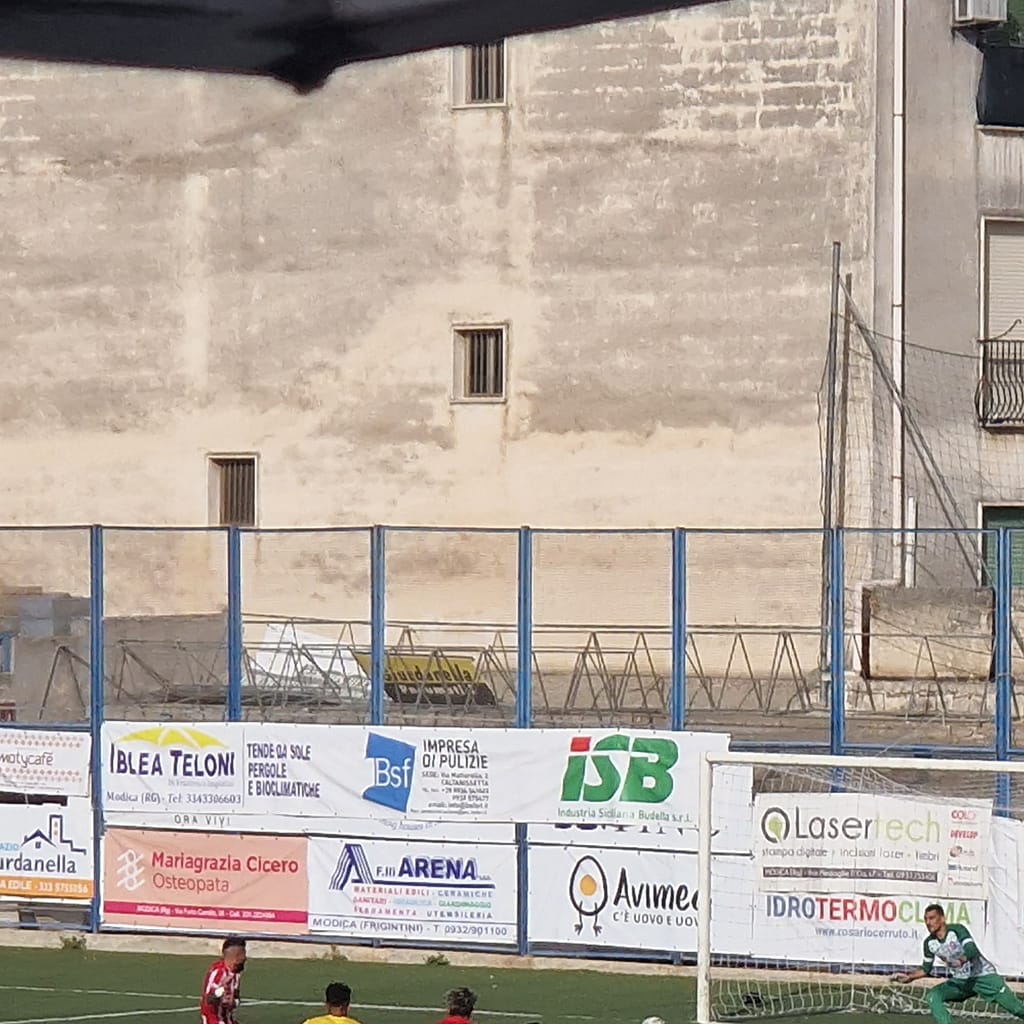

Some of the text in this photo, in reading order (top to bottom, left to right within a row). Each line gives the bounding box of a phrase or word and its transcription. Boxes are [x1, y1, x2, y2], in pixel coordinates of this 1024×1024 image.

[246, 742, 275, 759] TENDE
[290, 744, 311, 761] SOLE
[423, 738, 479, 754] IMPRESA
[109, 742, 235, 777] IBLEA TELONI
[439, 753, 489, 769] PULIZIE
[248, 762, 287, 779] PERGOLE
[375, 757, 412, 788] Bsf
[106, 790, 139, 803] Modica
[247, 780, 254, 797] E
[256, 780, 321, 799] BIOCLIMATICHE
[174, 814, 198, 825] ORA
[557, 807, 596, 818] Industria
[638, 810, 670, 822] Budella
[795, 806, 941, 844] Lasertech
[152, 851, 299, 873] Mariagrazia Cicero
[398, 856, 478, 881] ARENA
[152, 872, 230, 895] Osteopata
[354, 886, 493, 898] MATERIALI EDILI CERAMICHE
[427, 910, 493, 919] UTENSILERIA
[634, 912, 664, 924] UOVO
[666, 916, 673, 924] E
[766, 894, 971, 925] IDROTERMOCLMA
[312, 918, 357, 930] MODICA
[359, 919, 423, 934] (FRIGINTINI)
